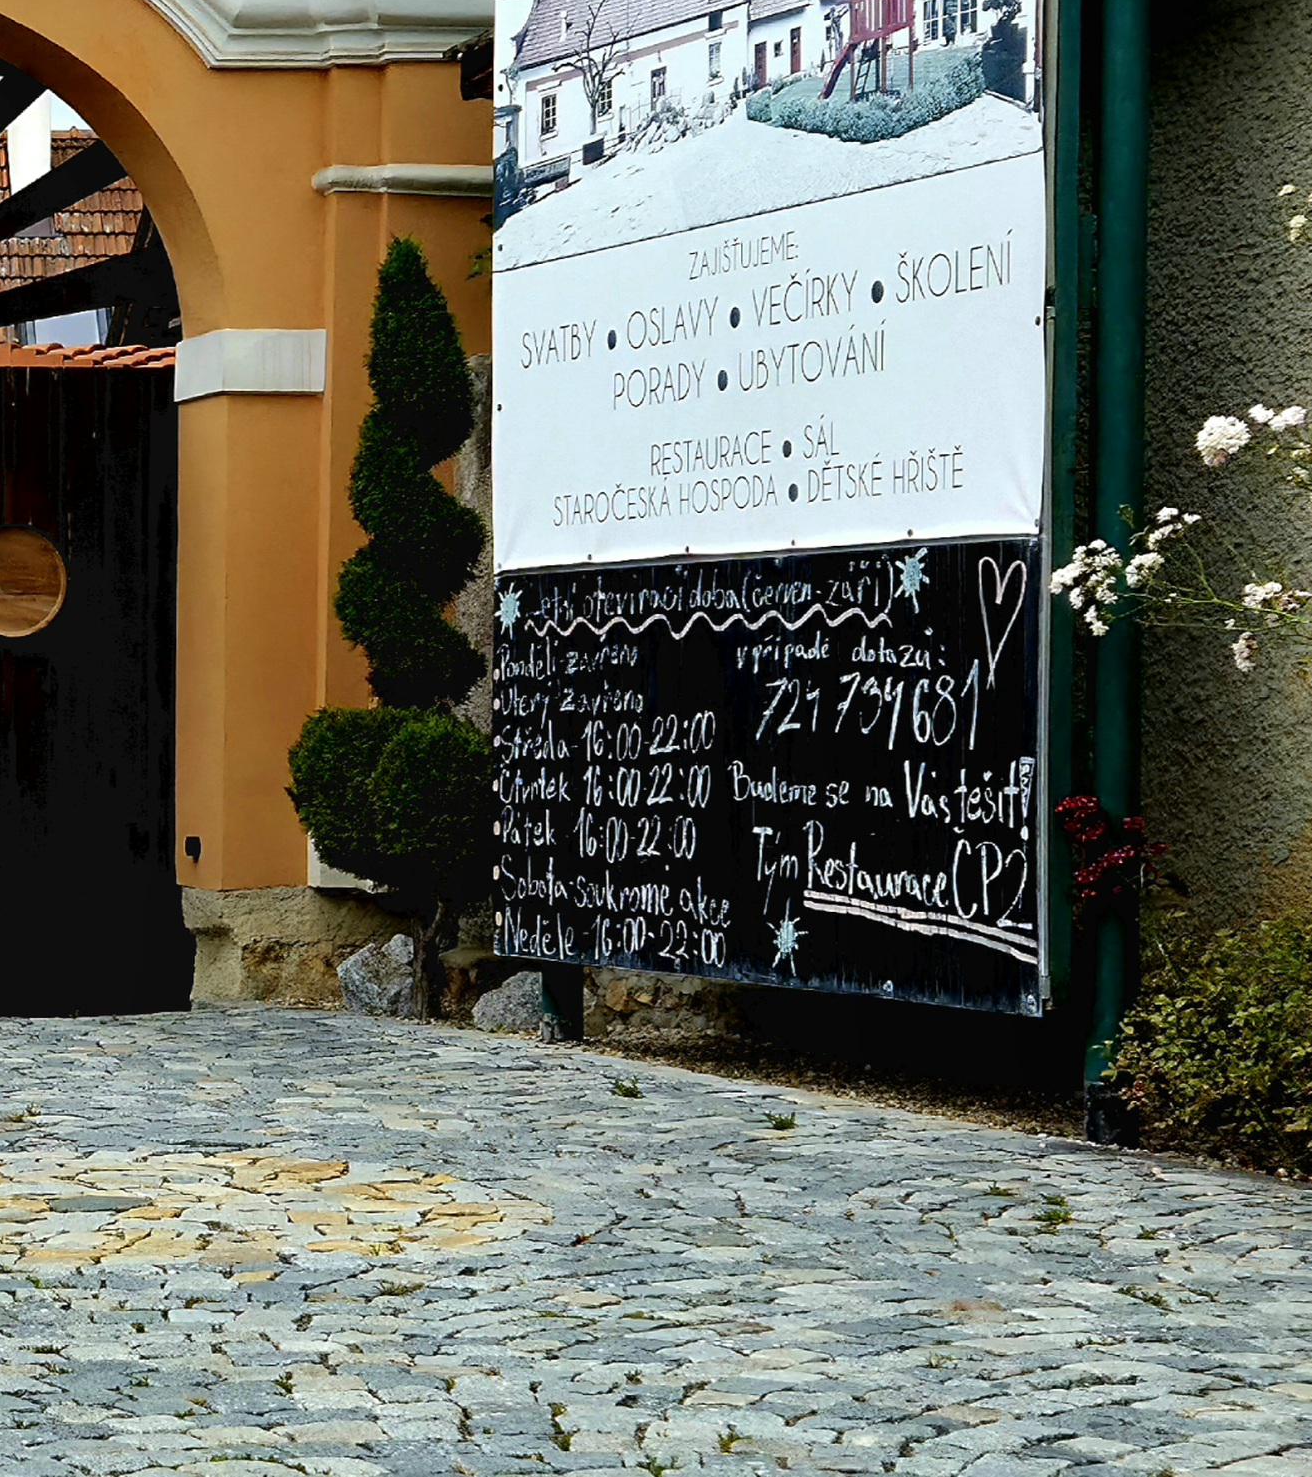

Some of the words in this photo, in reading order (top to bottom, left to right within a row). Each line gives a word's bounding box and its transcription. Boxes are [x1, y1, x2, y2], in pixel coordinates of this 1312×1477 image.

[688, 230, 799, 282] ZAJIŠŤUJEME:
[520, 319, 597, 370] SVATBY
[626, 295, 719, 351] OSLAVY
[751, 268, 858, 327] VEČÍRKY
[895, 228, 1014, 305] ŠKOLENÍ
[613, 359, 707, 411] PORADY
[737, 319, 886, 392] UBYTOVÁNÍ
[650, 429, 772, 477] RESTAURACE
[802, 414, 840, 459] SÁL
[553, 476, 672, 528] STAROČESKÁ
[679, 473, 779, 516] HOSPODA
[806, 453, 883, 504] DĚTSKÉ
[892, 444, 965, 496] HŘIŠTĚ
[688, 567, 741, 610] doba
[754, 676, 821, 742] 724
[912, 658, 979, 751] 681
[727, 759, 818, 807] Budeme
[824, 780, 850, 808] se
[865, 781, 893, 808] na
[903, 759, 951, 824] Vás
[679, 875, 732, 928] akce
[752, 825, 800, 916] Tým
[802, 819, 950, 908] Restaurace
